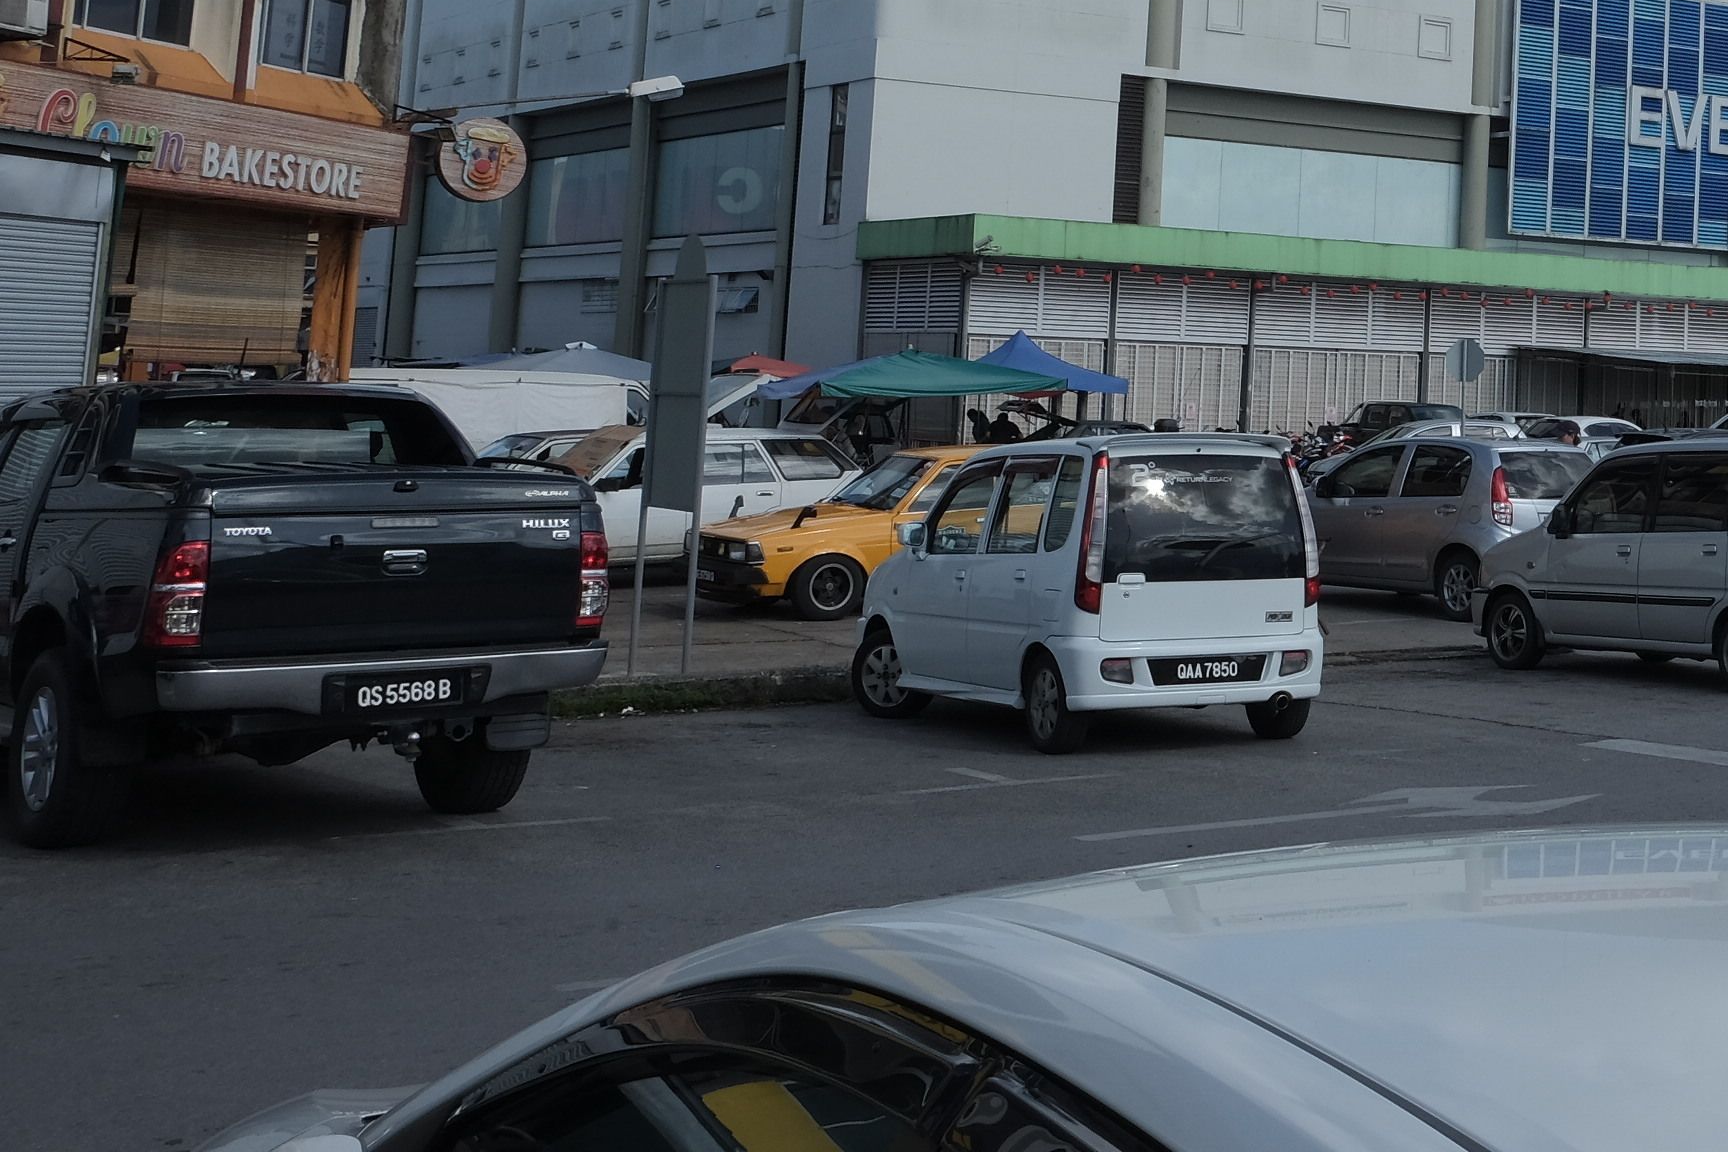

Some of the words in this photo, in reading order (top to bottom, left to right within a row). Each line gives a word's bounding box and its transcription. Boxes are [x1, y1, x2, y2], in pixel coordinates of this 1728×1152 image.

[201, 140, 364, 199] BAKESTORE
[224, 526, 272, 537] TOYOTA
[522, 519, 570, 529] HILUX
[1177, 663, 1203, 679] QAA
[1204, 661, 1238, 678] 7850
[358, 686, 383, 707] QS
[385, 680, 436, 704] 5568
[439, 678, 451, 699] B
